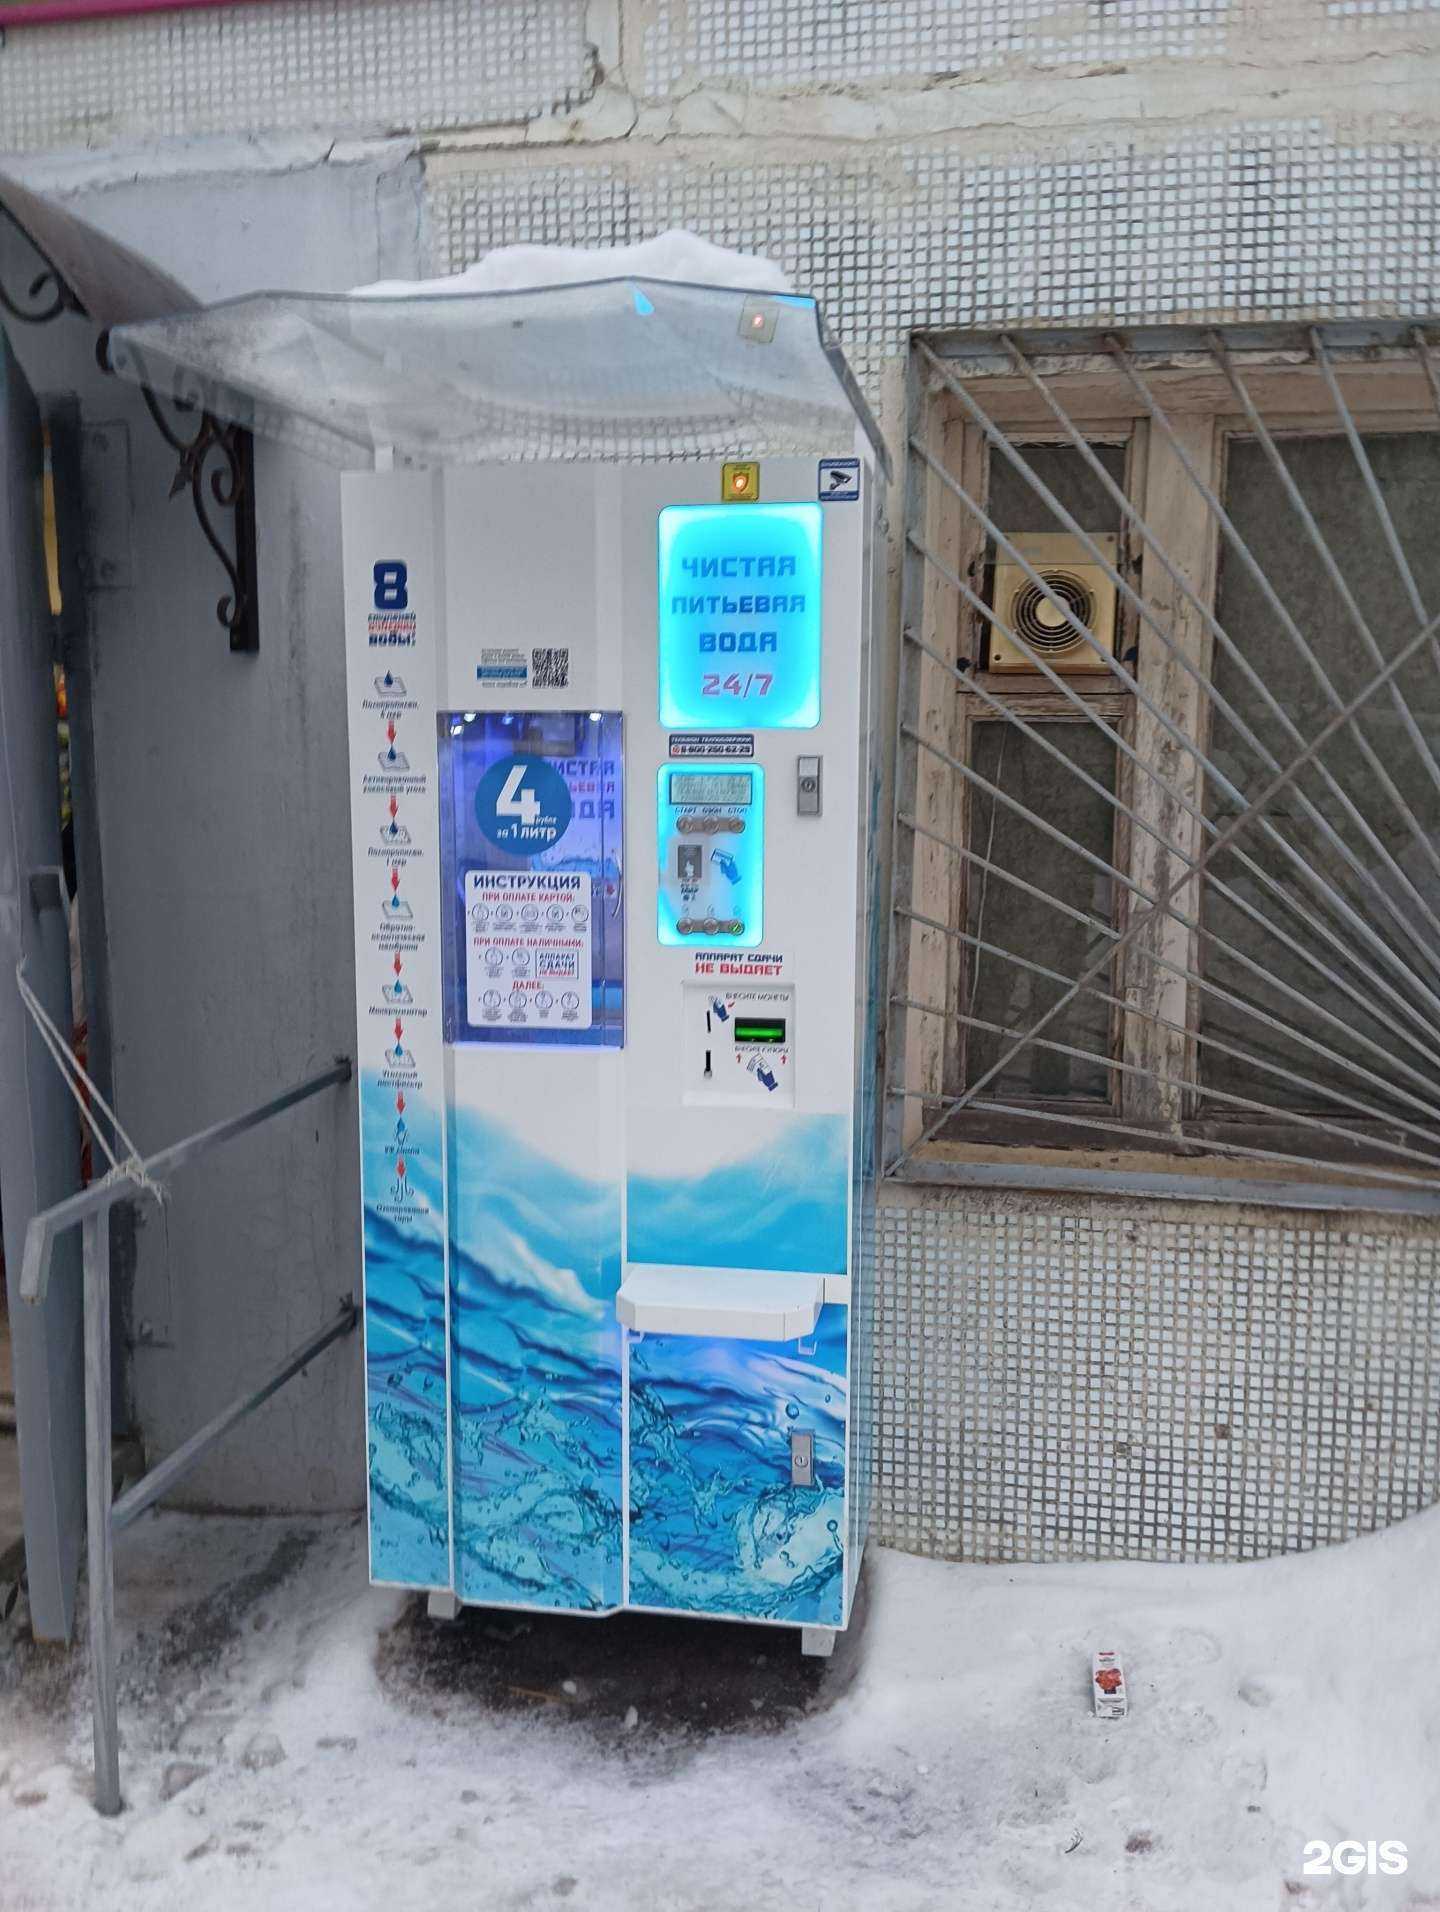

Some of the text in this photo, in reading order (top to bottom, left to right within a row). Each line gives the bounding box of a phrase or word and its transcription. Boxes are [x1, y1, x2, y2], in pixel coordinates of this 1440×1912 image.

[682, 555, 796, 578] ЧИСТАЯ
[373, 560, 408, 609] 8
[672, 595, 806, 615] ПИТЬЕВАЯ
[700, 632, 777, 653] ВОДА
[702, 673, 773, 698] 24/7
[496, 765, 541, 825] 4
[511, 823, 518, 838] 1
[520, 826, 557, 842] литр
[473, 875, 581, 891] ИНСТРУКЦИЯ
[482, 892, 500, 901] ПРИ
[502, 892, 536, 901] ОПЛАТЕ
[473, 937, 491, 946] ПРИ
[493, 938, 525, 946] ОПЛАТЕ
[695, 952, 783, 963] АППАРАТ СДАЧИ
[695, 963, 783, 976] НЕ ВЫДАЕТ
